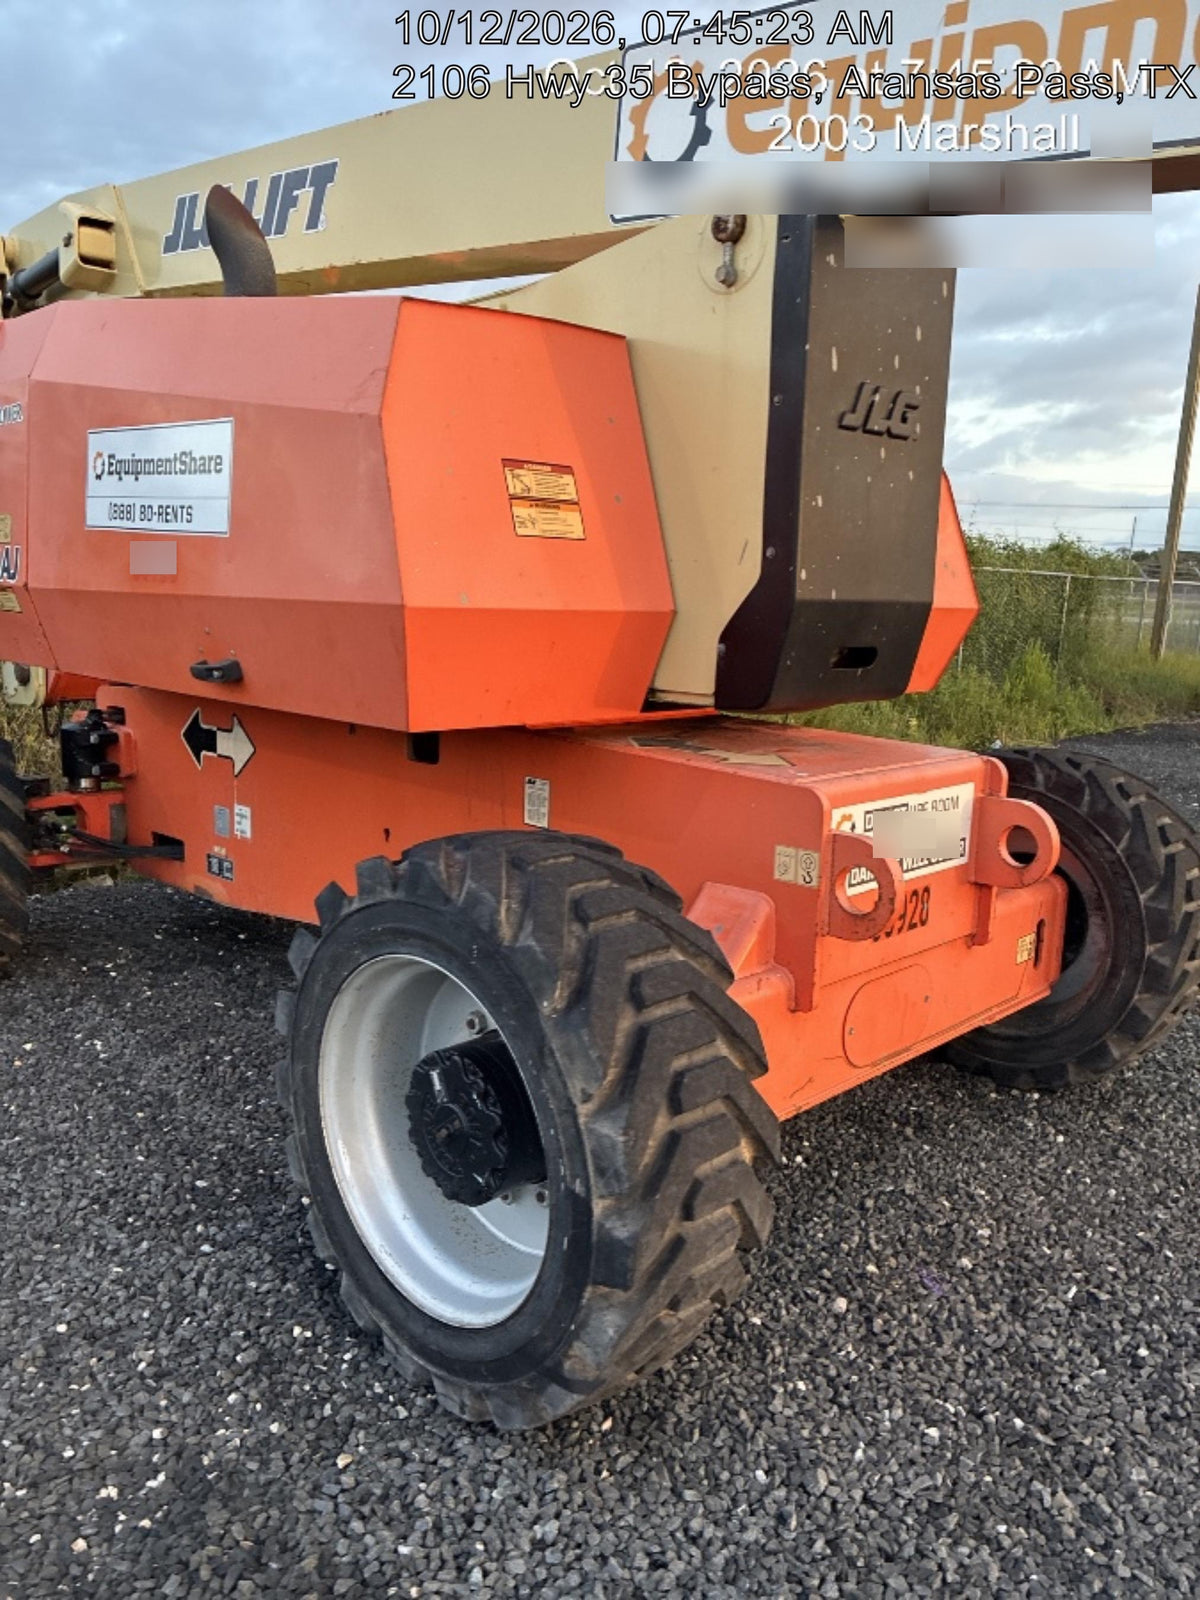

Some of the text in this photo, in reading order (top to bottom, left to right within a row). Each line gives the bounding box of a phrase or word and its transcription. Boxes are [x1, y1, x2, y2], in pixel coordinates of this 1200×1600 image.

[725, 0, 1200, 162] equipm
[838, 381, 919, 441] JLG
[107, 450, 223, 481] EquipmentShare
